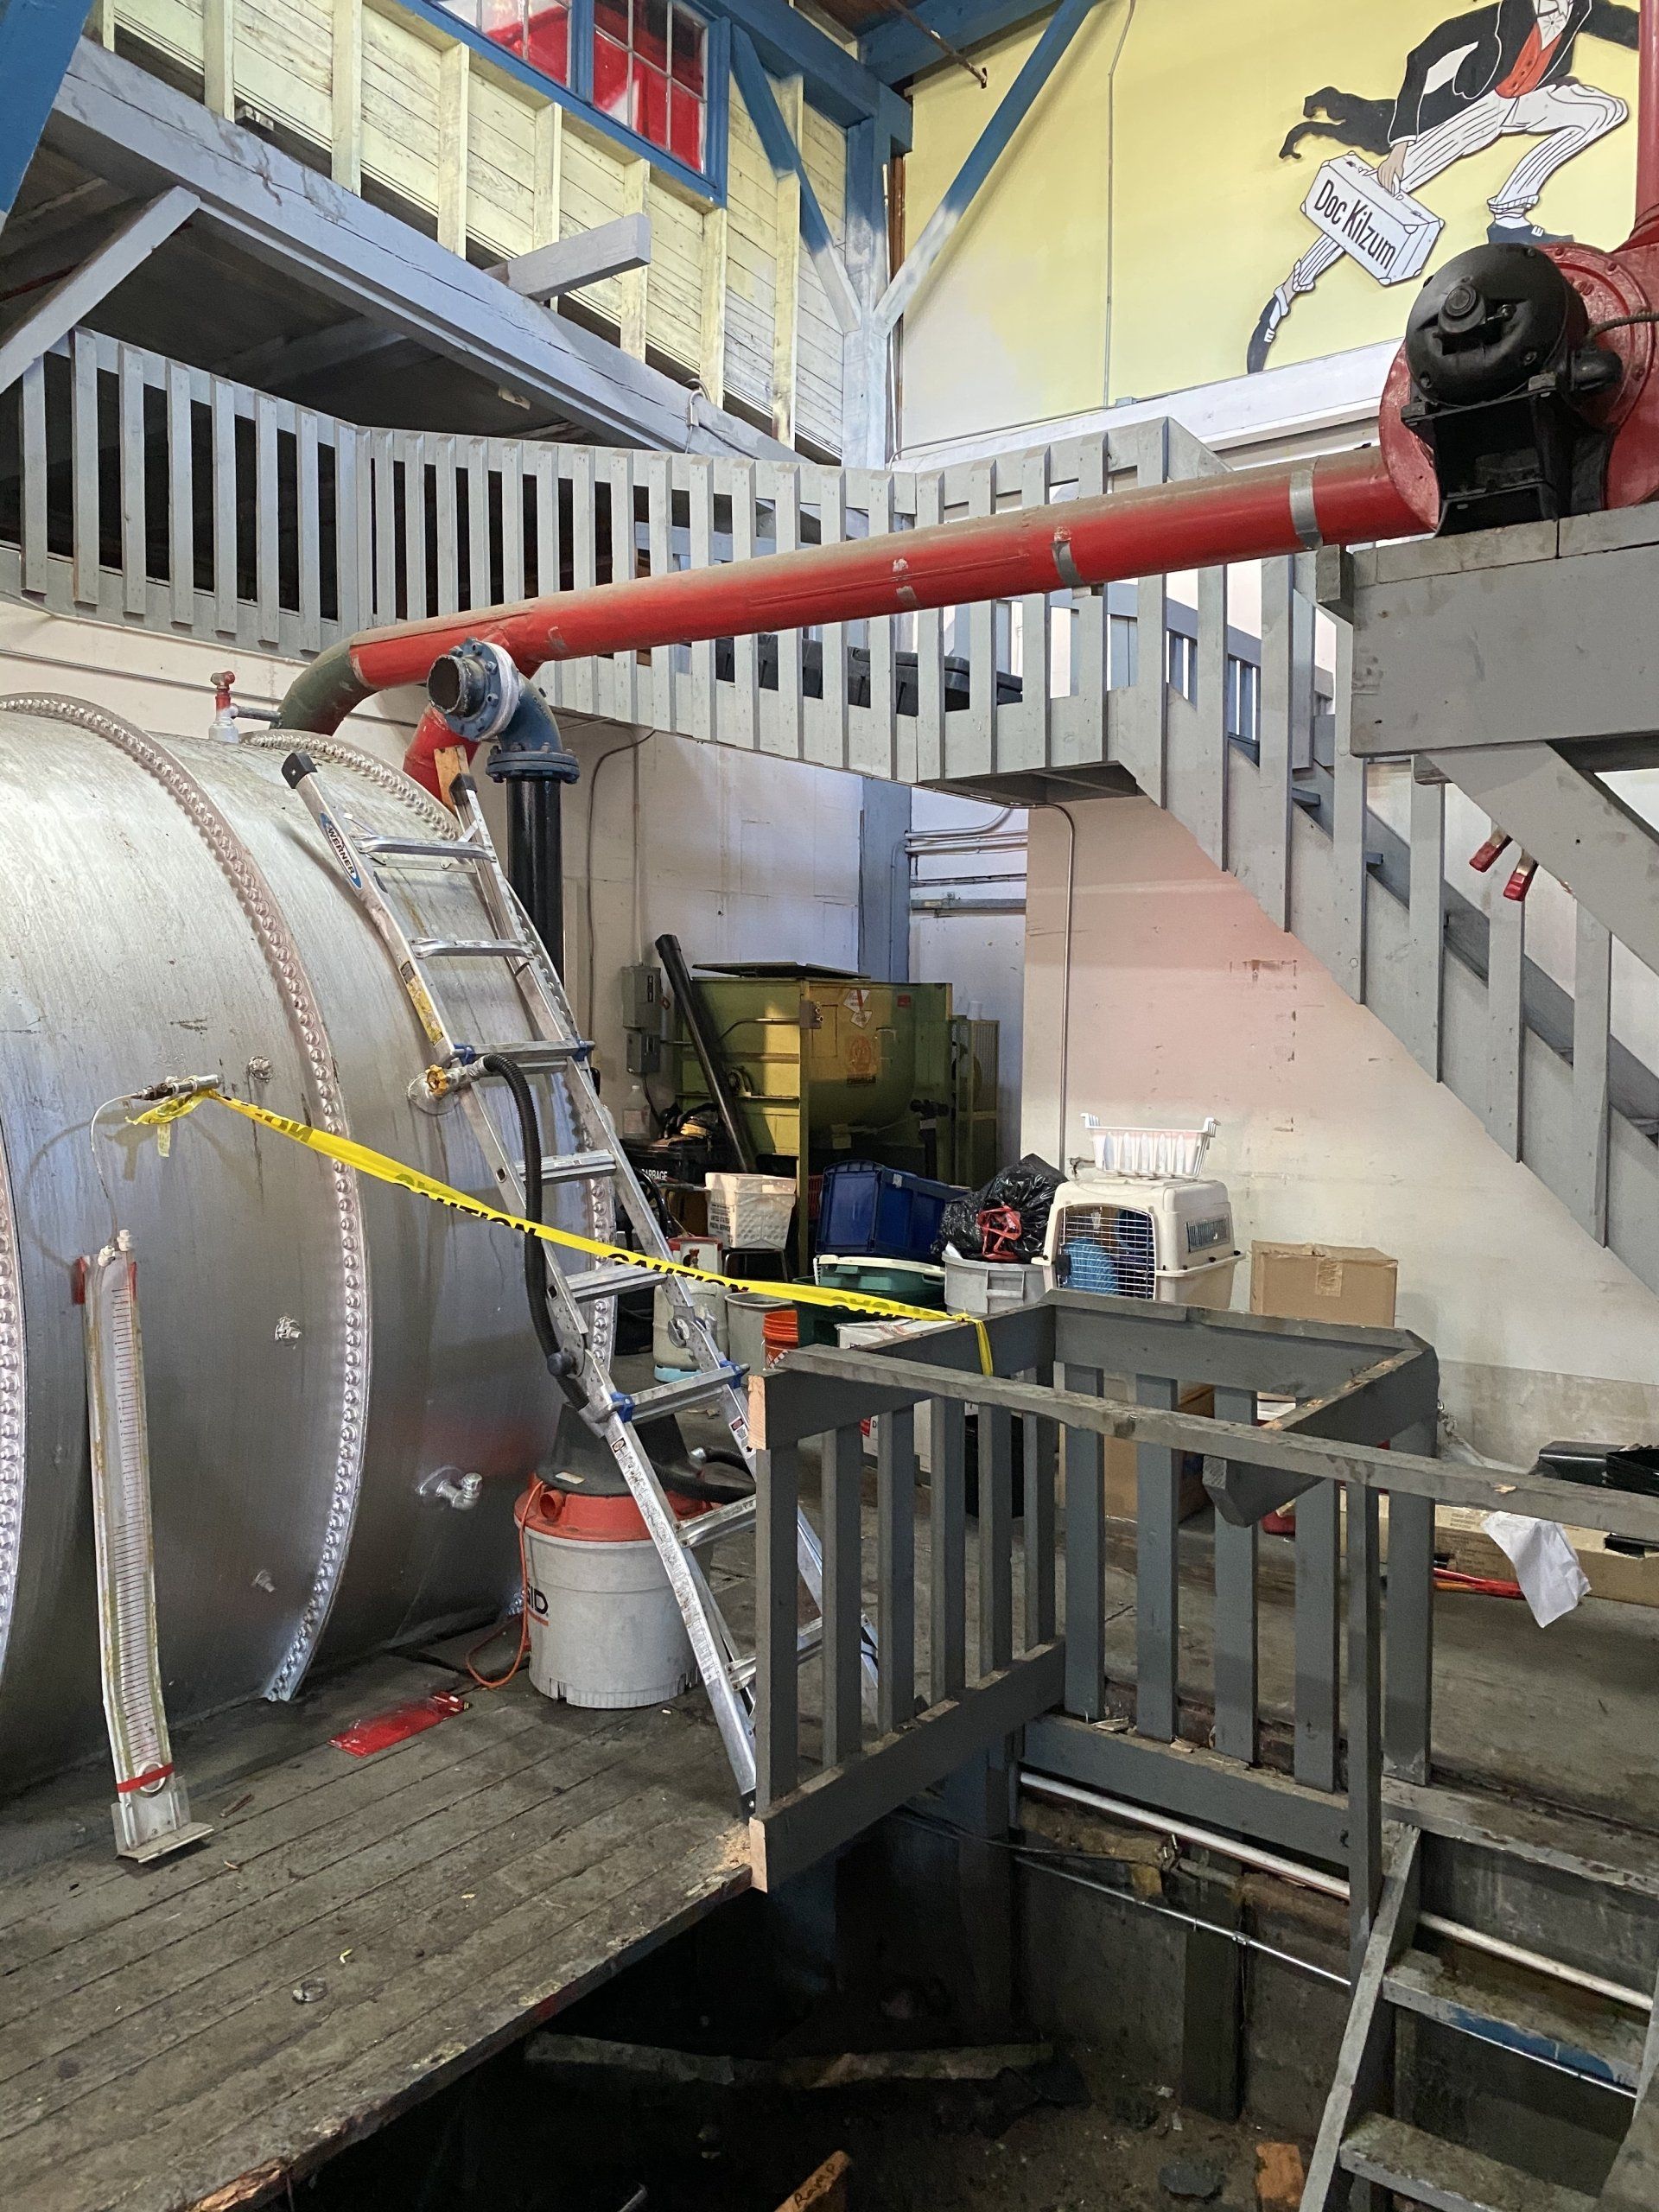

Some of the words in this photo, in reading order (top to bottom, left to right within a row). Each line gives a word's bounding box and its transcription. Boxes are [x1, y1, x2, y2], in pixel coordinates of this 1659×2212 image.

[1313, 179, 1348, 226] Doc
[1341, 199, 1396, 270] Kilzum
[327, 827, 356, 874] WERNER
